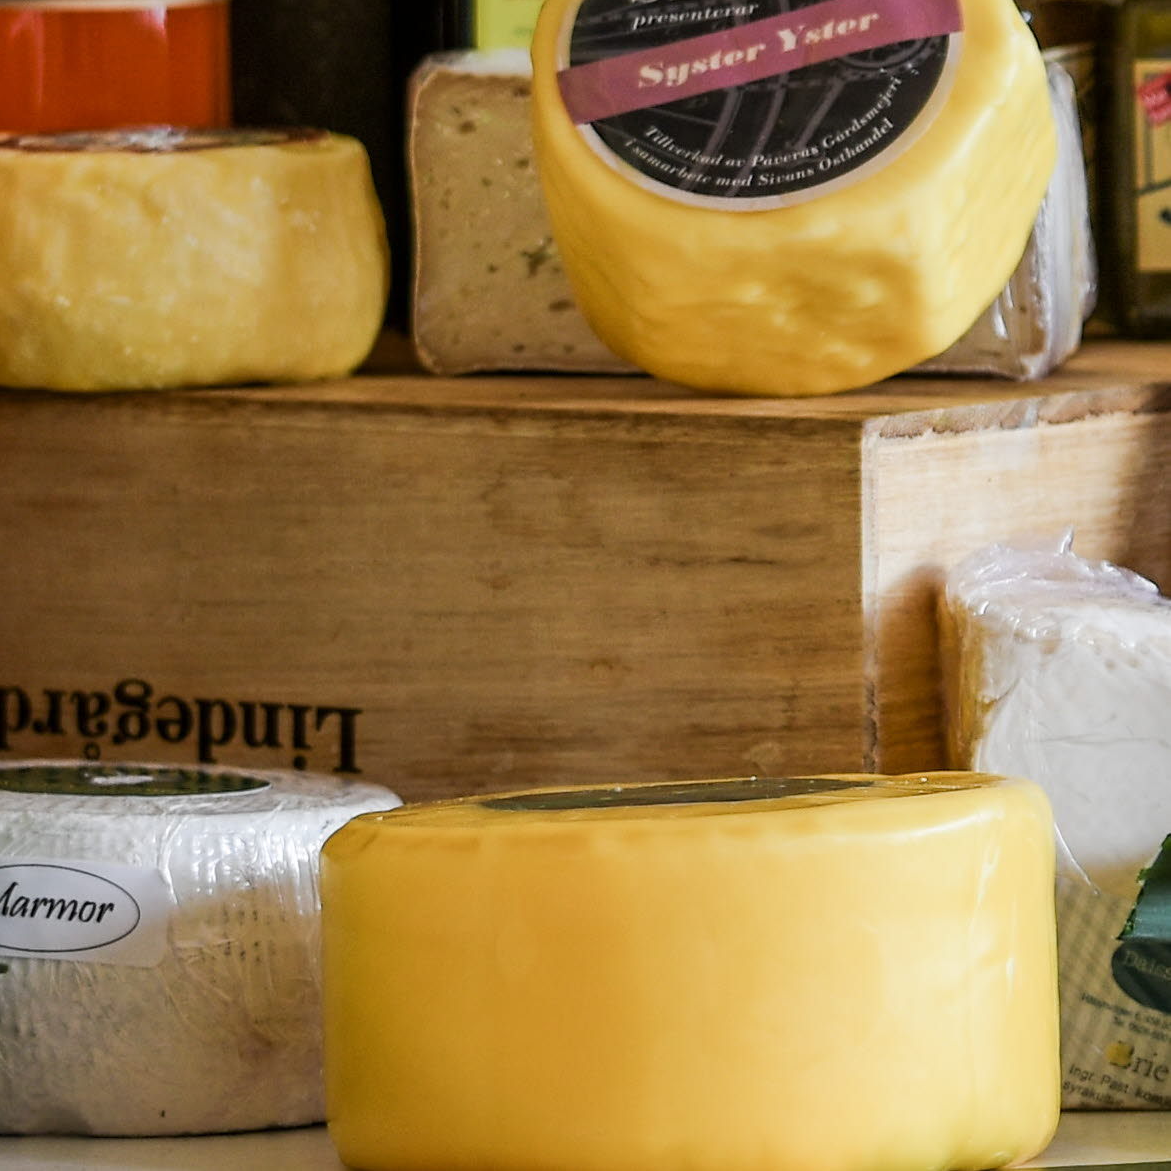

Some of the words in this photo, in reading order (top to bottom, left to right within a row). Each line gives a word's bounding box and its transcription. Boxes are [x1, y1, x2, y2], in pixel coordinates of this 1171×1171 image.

[632, 3, 760, 31] presenterar
[638, 43, 767, 88] Syster
[776, 13, 881, 53] Yster
[631, 146, 712, 184] samarbete
[715, 174, 754, 188] med
[757, 167, 816, 187] Sivans
[818, 116, 895, 172] Osthandel
[645, 125, 723, 166] Tillverkad
[724, 158, 746, 168] av
